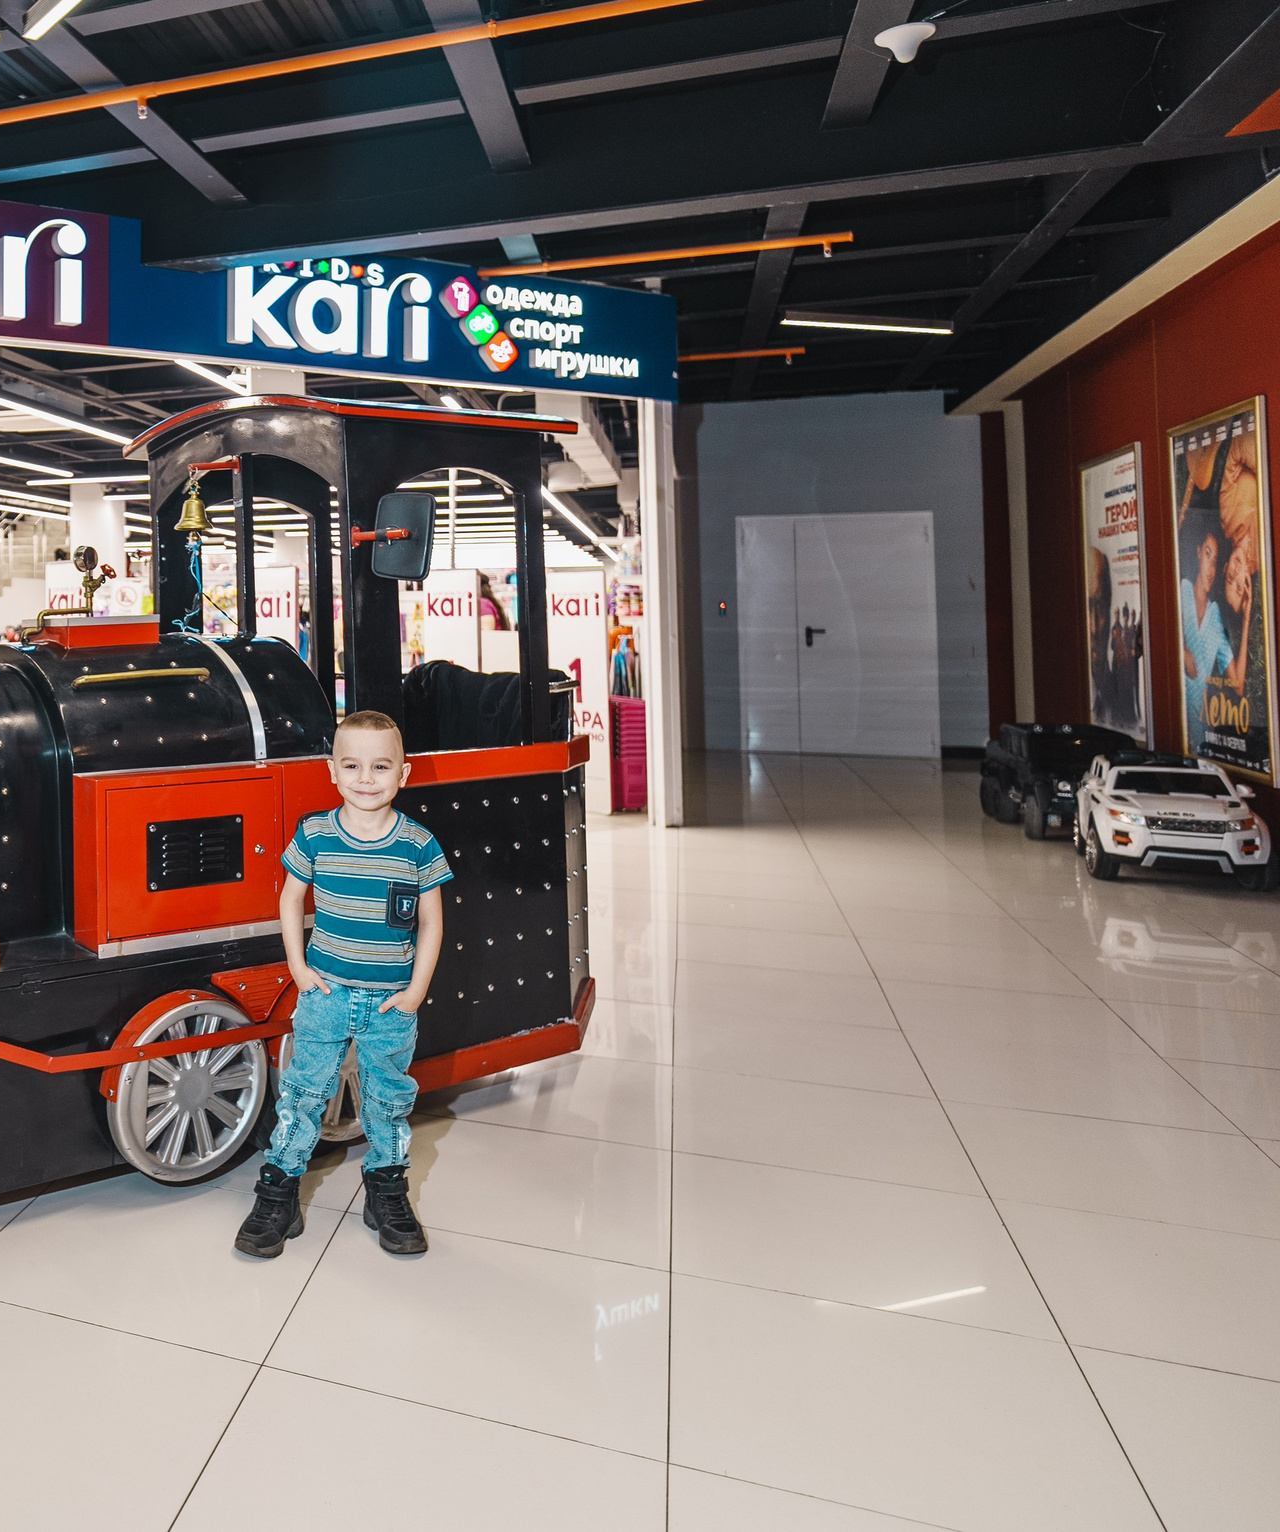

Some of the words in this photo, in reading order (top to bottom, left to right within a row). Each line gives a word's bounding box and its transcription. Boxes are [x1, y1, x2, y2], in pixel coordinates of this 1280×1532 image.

[226, 265, 432, 364] kari
[484, 284, 584, 318] одежда
[508, 317, 584, 349] спорт
[532, 347, 640, 379] игрушки
[1105, 496, 1138, 524] ГЕРОЙ
[427, 592, 473, 617] kari
[551, 592, 600, 617] kari
[568, 657, 583, 703] 1
[401, 899, 412, 912] F
